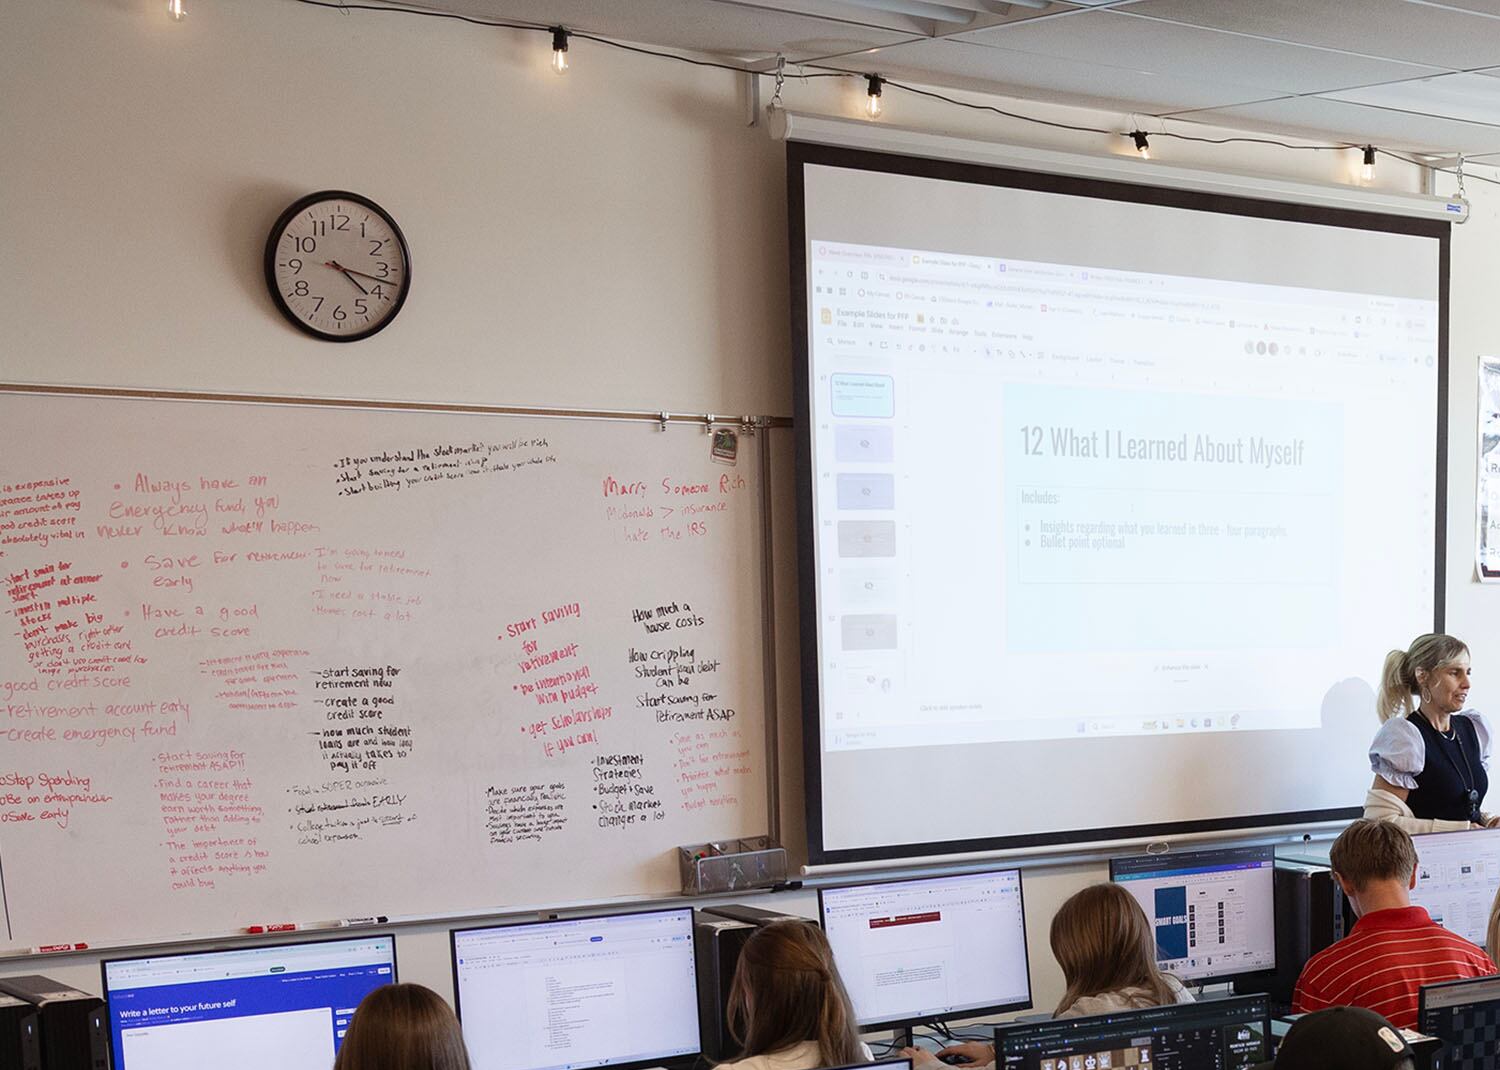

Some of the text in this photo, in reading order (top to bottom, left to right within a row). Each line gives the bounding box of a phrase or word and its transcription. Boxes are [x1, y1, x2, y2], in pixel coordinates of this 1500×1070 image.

[312, 220, 325, 236] 11
[330, 214, 351, 231] 12
[360, 222, 365, 238] 1
[295, 236, 316, 253] 10
[369, 240, 382, 256] 2
[288, 258, 302, 275] 9
[376, 262, 389, 278] 3
[295, 280, 309, 296] 8
[370, 284, 384, 300] 4
[312, 296, 324, 312] 7
[354, 298, 368, 315] 5
[333, 305, 347, 321] 6
[1020, 425, 1305, 469] 12 What I Learned About Myself
[370, 450, 414, 462] understand
[135, 472, 268, 505] Always have an
[603, 473, 746, 499] Marry Someone Rich
[681, 502, 727, 517] insurance
[1040, 520, 1219, 537] Insights regarding what you learned three
[1040, 535, 1126, 551] Bullet point optional
[144, 555, 201, 571] Save
[153, 576, 193, 594] early
[142, 603, 259, 622] Have a good
[632, 601, 691, 623] How much a
[155, 623, 250, 638] credit score
[506, 617, 537, 638] Start
[644, 614, 705, 634] house costs
[522, 640, 538, 656] for
[628, 646, 695, 664] How crippling
[322, 665, 402, 680] start saving for
[635, 659, 721, 678] Student debt
[4, 675, 90, 701] good credit
[315, 678, 393, 689] retirement now
[678, 674, 690, 686] be
[325, 695, 395, 708] create a good
[636, 692, 666, 707] Start
[8, 697, 191, 724] retirement account early
[327, 709, 383, 720] credit score
[706, 707, 735, 721] ASAP
[64, 720, 177, 747] emergency fund
[323, 725, 412, 737] how much student
[319, 736, 379, 750] loans are and
[158, 750, 229, 762] Start saving
[366, 750, 407, 759] takes to
[597, 754, 643, 766] Investment
[330, 760, 377, 773] pay off
[6, 770, 90, 792] Stop Spending
[197, 777, 252, 789] career that
[593, 767, 642, 783] Strategies
[28, 795, 40, 803] an
[160, 793, 214, 804] makes your
[487, 785, 527, 797] Make sure
[599, 783, 627, 799] Budget
[187, 804, 216, 814] worth
[599, 800, 662, 814] Stock market
[39, 807, 69, 829] early
[163, 815, 196, 825] rather
[599, 811, 665, 829] changes a lot
[167, 837, 244, 850] The importance
[180, 851, 239, 863] credit score
[172, 878, 195, 890] could
[119, 999, 237, 1019] Write a letter to your future self
